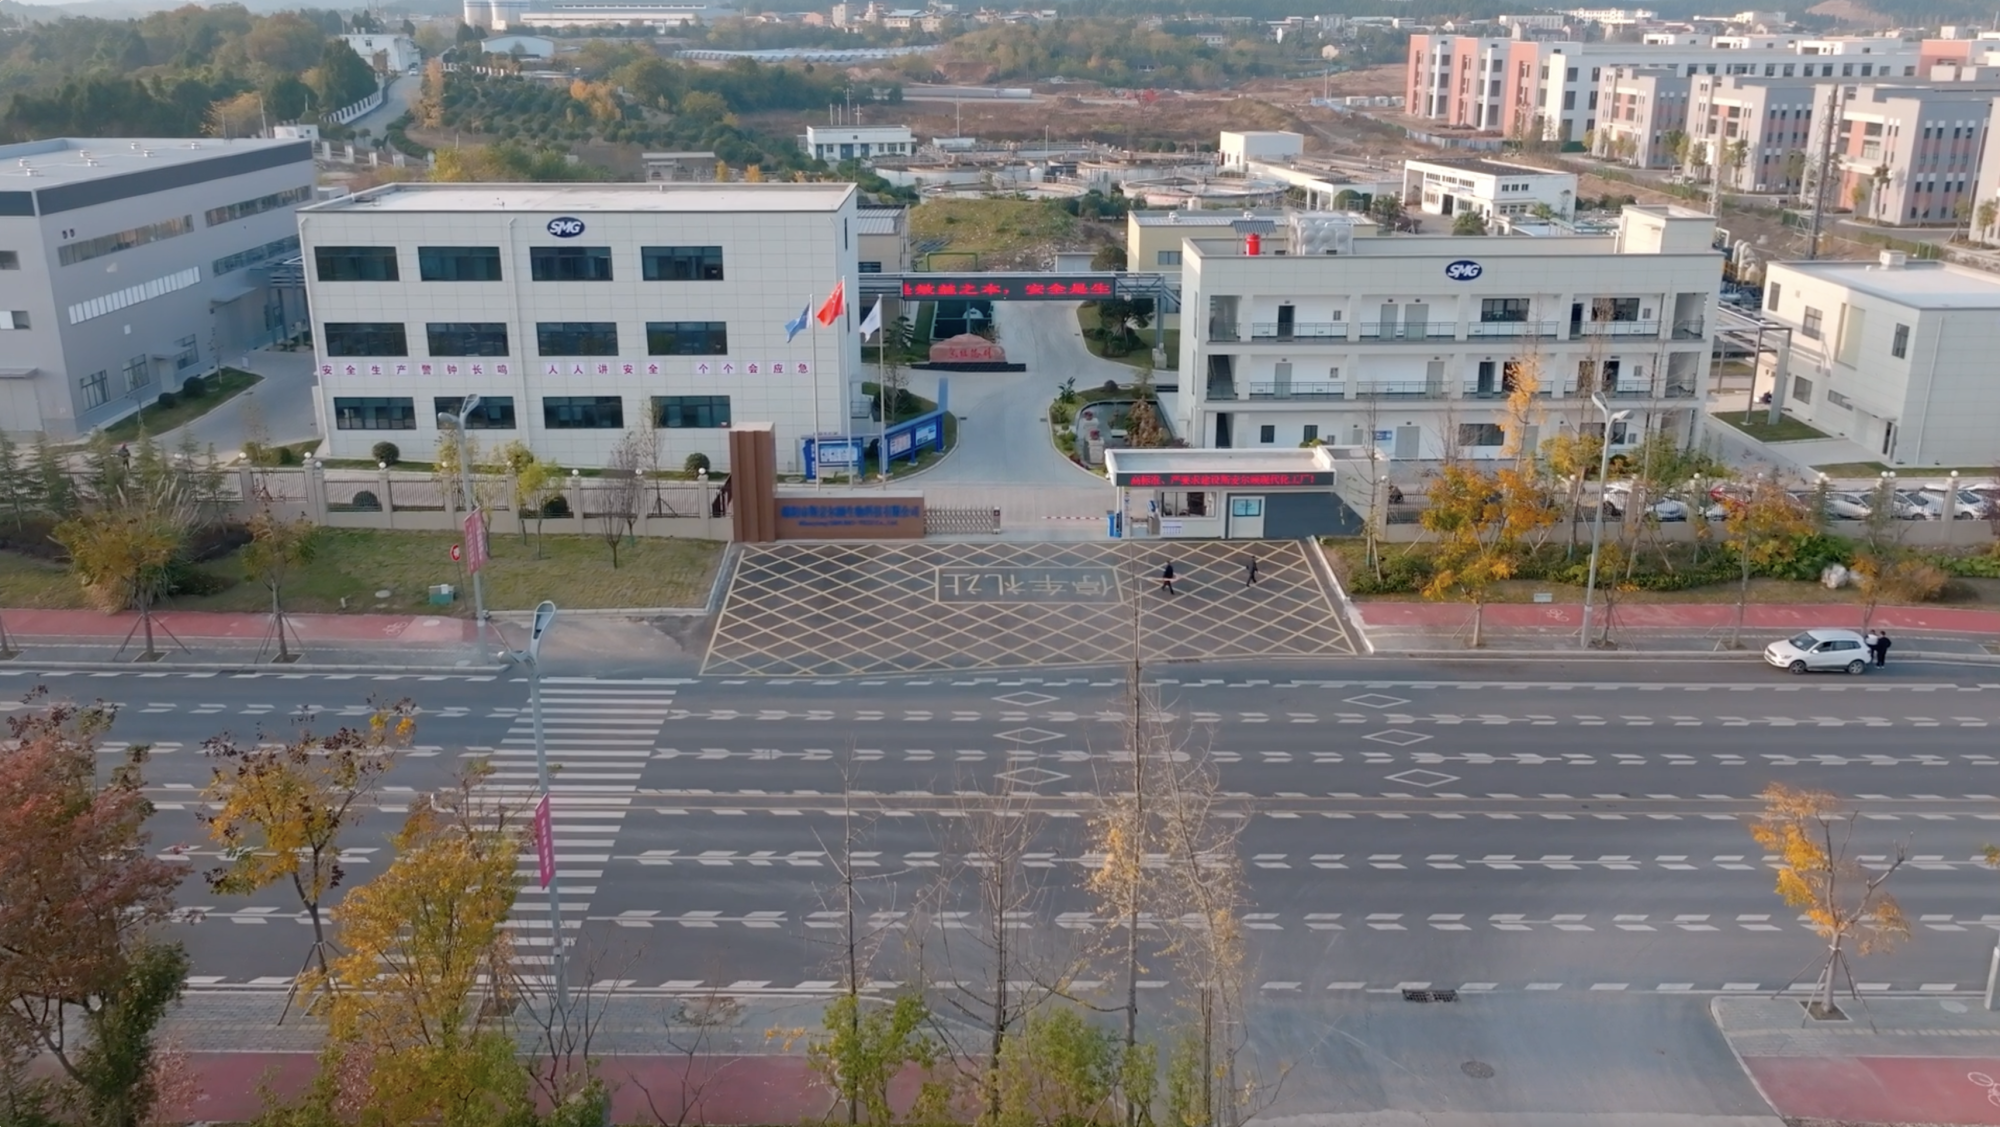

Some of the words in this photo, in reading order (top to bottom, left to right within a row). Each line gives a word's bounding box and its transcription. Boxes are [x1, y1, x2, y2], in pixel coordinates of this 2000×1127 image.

[549, 220, 582, 235] SMG
[1448, 263, 1481, 278] SMG
[322, 364, 508, 376] 安全生产警钟长鸣
[548, 364, 659, 375] 人人讲安全
[698, 363, 809, 375] 个个会应急
[942, 574, 1114, 596] 停车礼让
